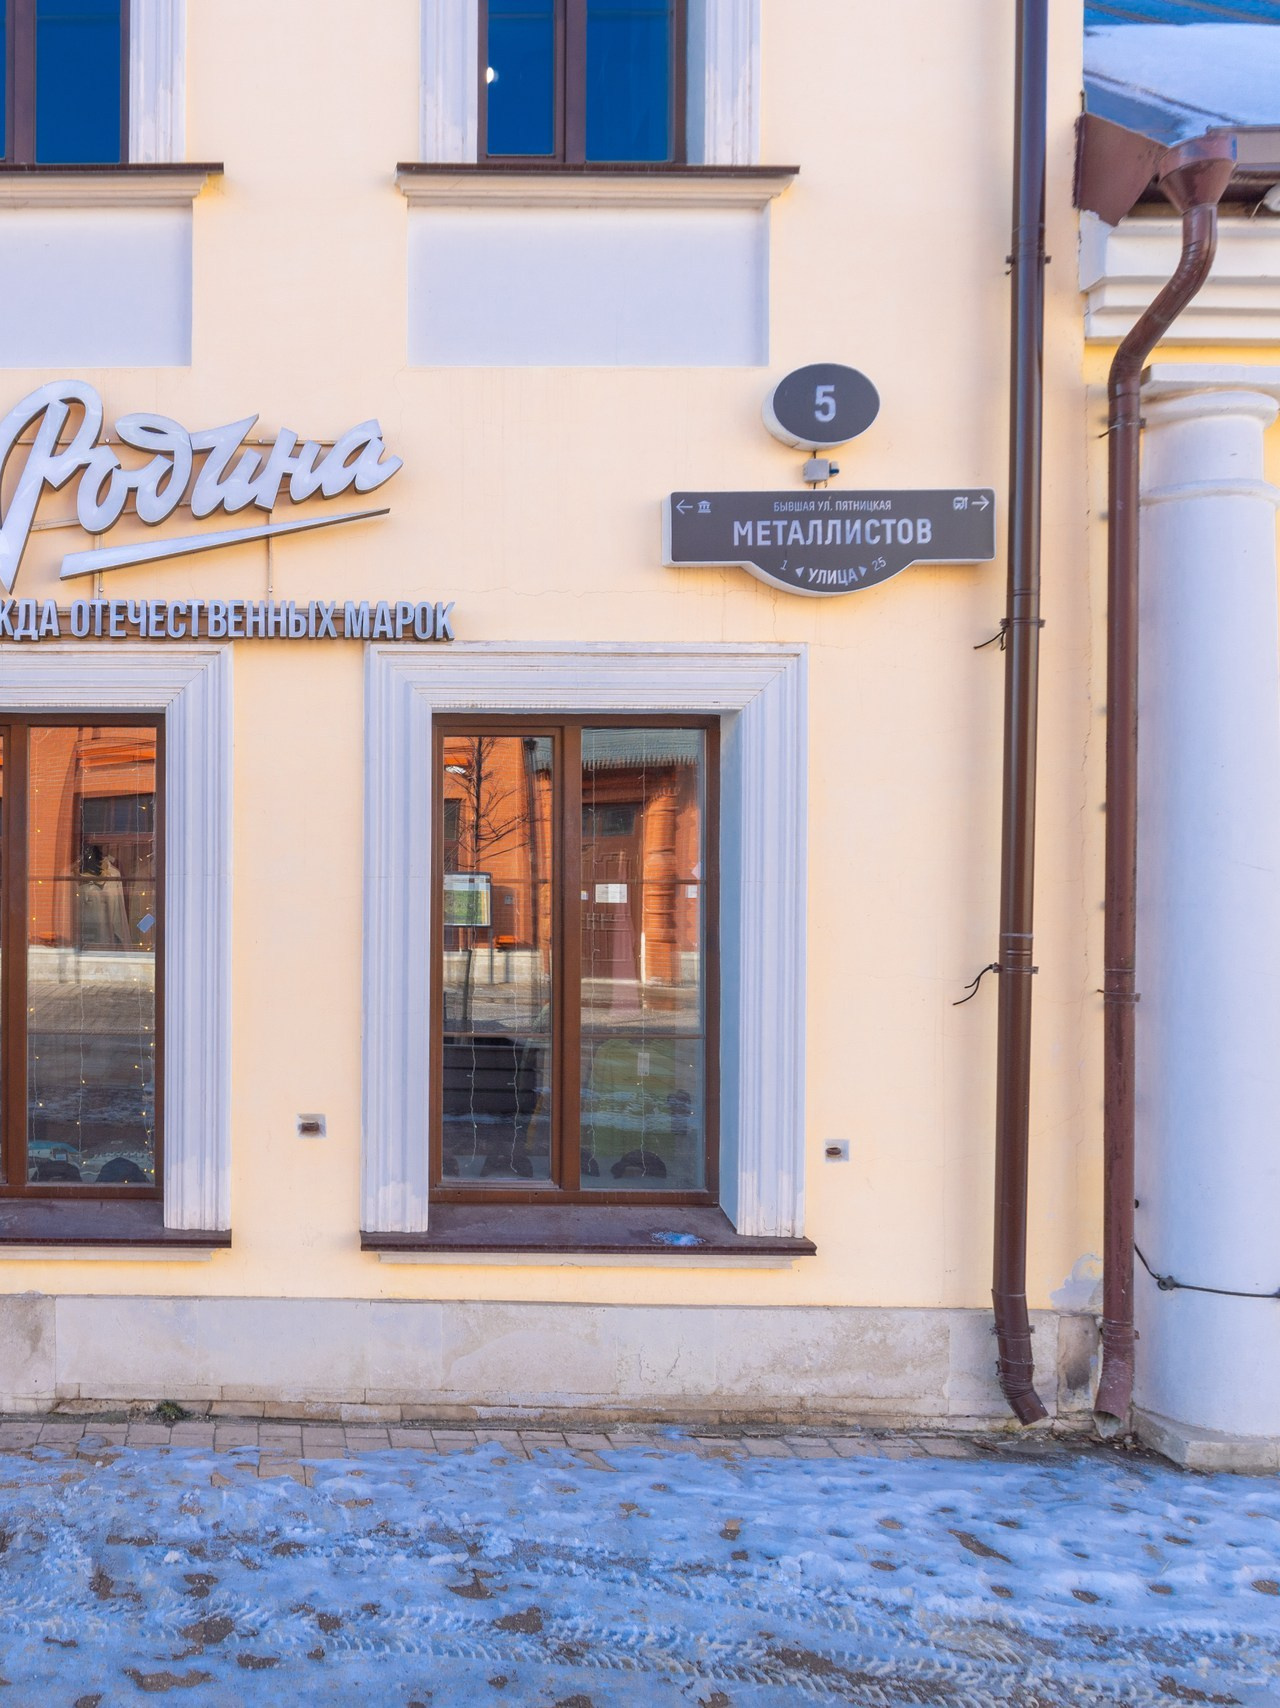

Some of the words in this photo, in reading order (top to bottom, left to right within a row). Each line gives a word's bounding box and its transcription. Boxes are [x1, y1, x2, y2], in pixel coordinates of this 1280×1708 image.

[814, 384, 837, 423] 5
[773, 501, 815, 512] БЫВШАЯ
[817, 500, 833, 512] УЛ.
[835, 499, 892, 513] ПЯТНИЦКАЯ
[733, 517, 932, 546] МЕТАЛЛИСТОВ
[780, 559, 788, 571] 1
[871, 556, 887, 572] 25
[808, 567, 859, 586] УЛИЦА
[70, 599, 338, 640] ОТЕЧЕСТВЕННЫХ
[344, 600, 456, 642] МАРОК
